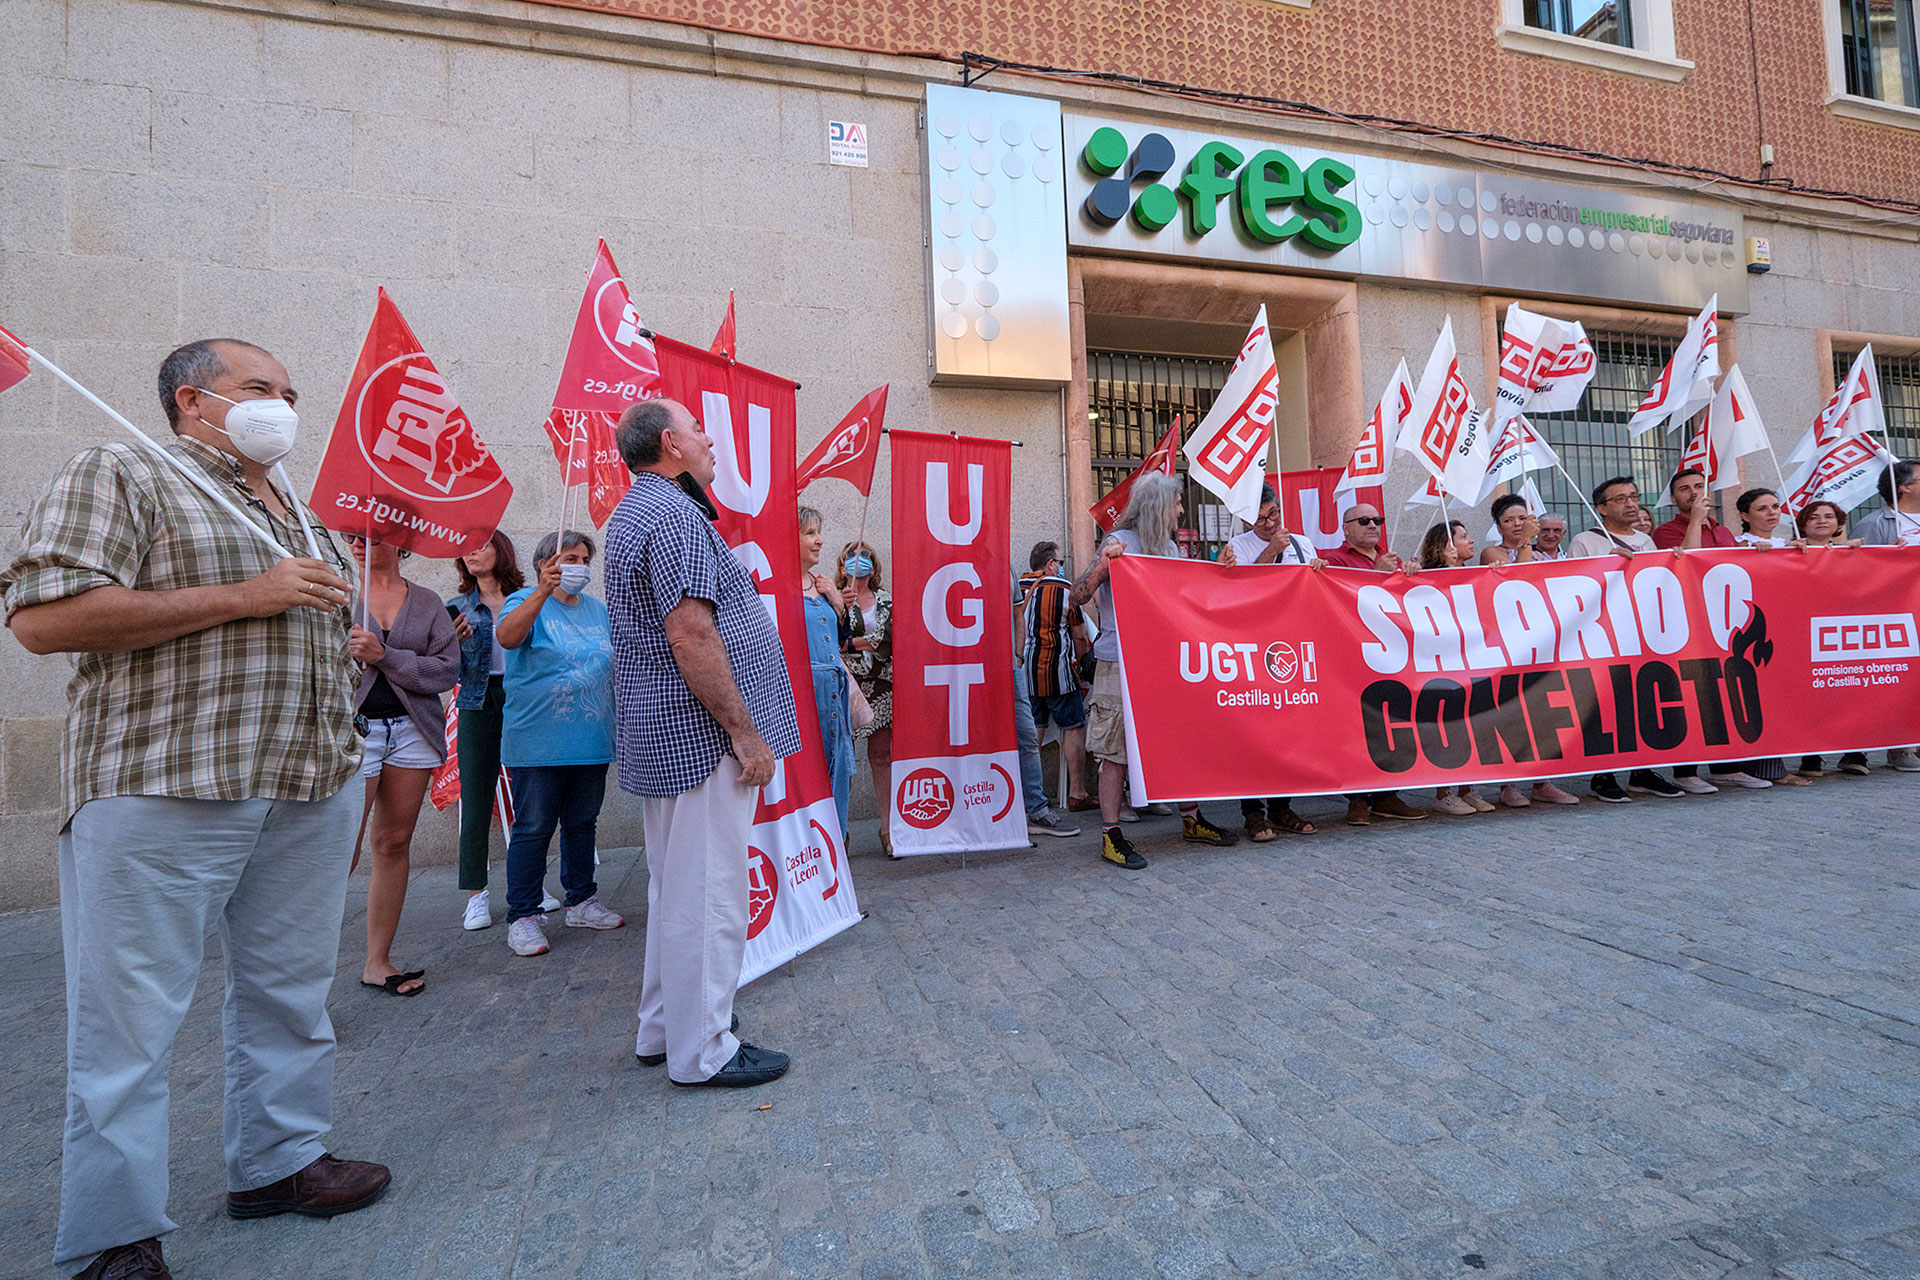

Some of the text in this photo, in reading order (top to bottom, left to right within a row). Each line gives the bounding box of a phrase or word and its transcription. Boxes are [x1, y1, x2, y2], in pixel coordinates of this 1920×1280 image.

[1179, 140, 1363, 251] fes
[922, 461, 986, 747] UGT
[1357, 563, 1754, 675] SALARIO O
[1818, 622, 1911, 653] CCOO
[1179, 641, 1259, 684] UGT
[1811, 662, 1909, 677] comisiones obreras
[1812, 673, 1900, 689] de Castilla y León
[1216, 688, 1319, 710] Castilla y León
[1360, 655, 1764, 774] CONFLICTO
[903, 777, 947, 804] UGT
[962, 780, 996, 796] Castilla
[784, 845, 823, 873] Castilla
[794, 863, 819, 886] León
